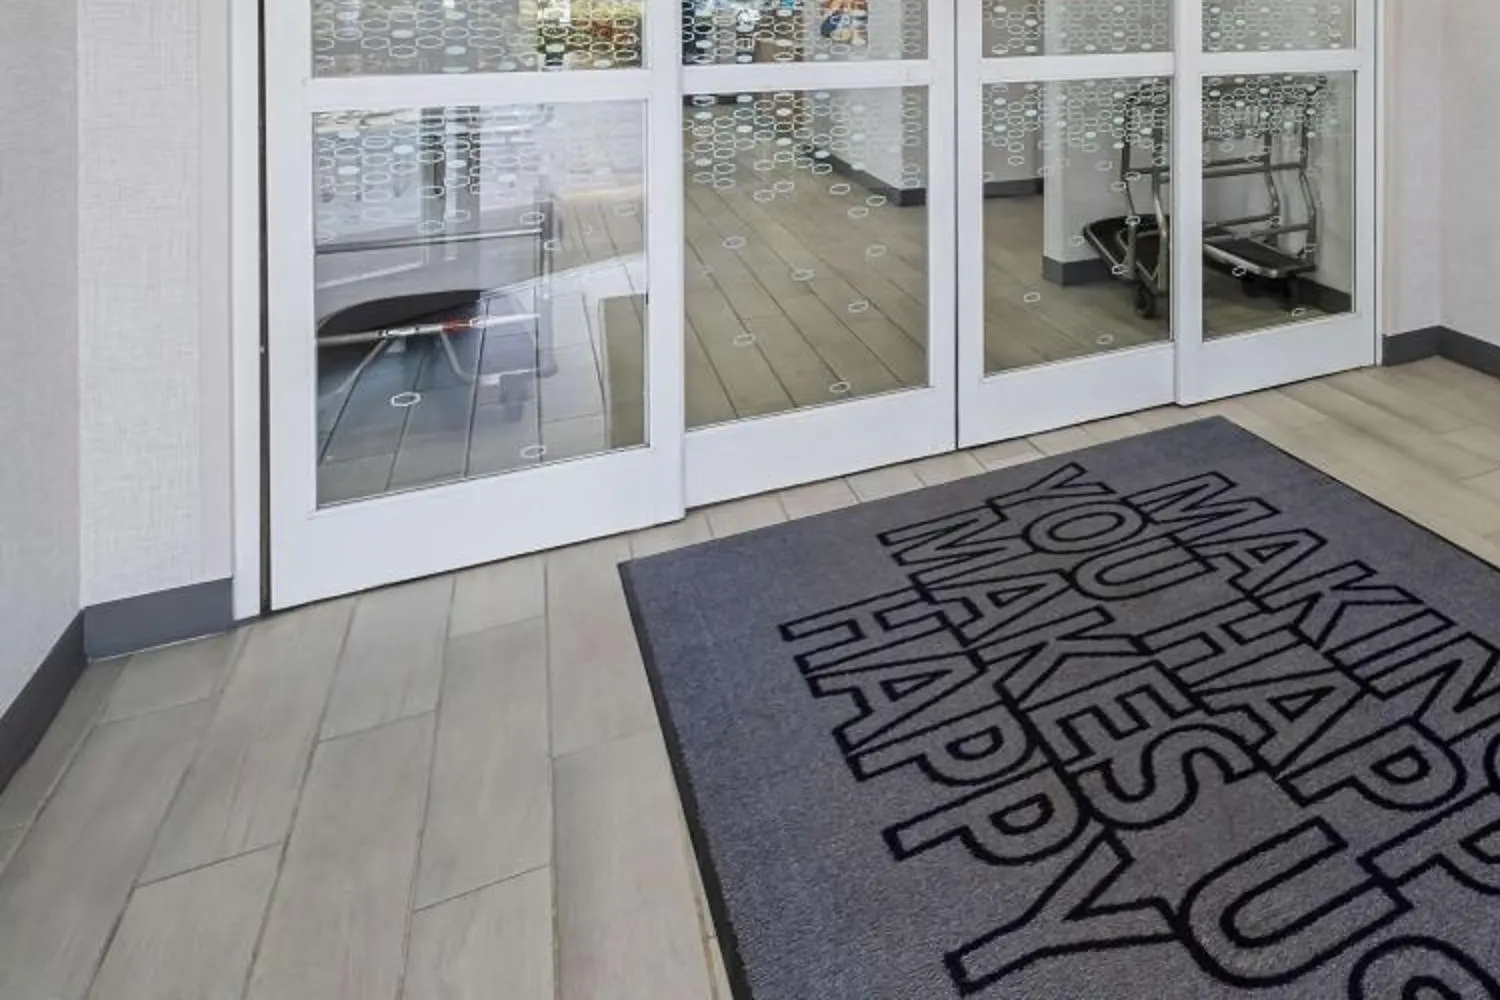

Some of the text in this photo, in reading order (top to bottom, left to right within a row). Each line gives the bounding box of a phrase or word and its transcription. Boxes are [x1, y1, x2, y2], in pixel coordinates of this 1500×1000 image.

[876, 505, 1257, 830] MAKES
[985, 462, 1218, 600] YOU
[778, 588, 1185, 996] HAPPY
